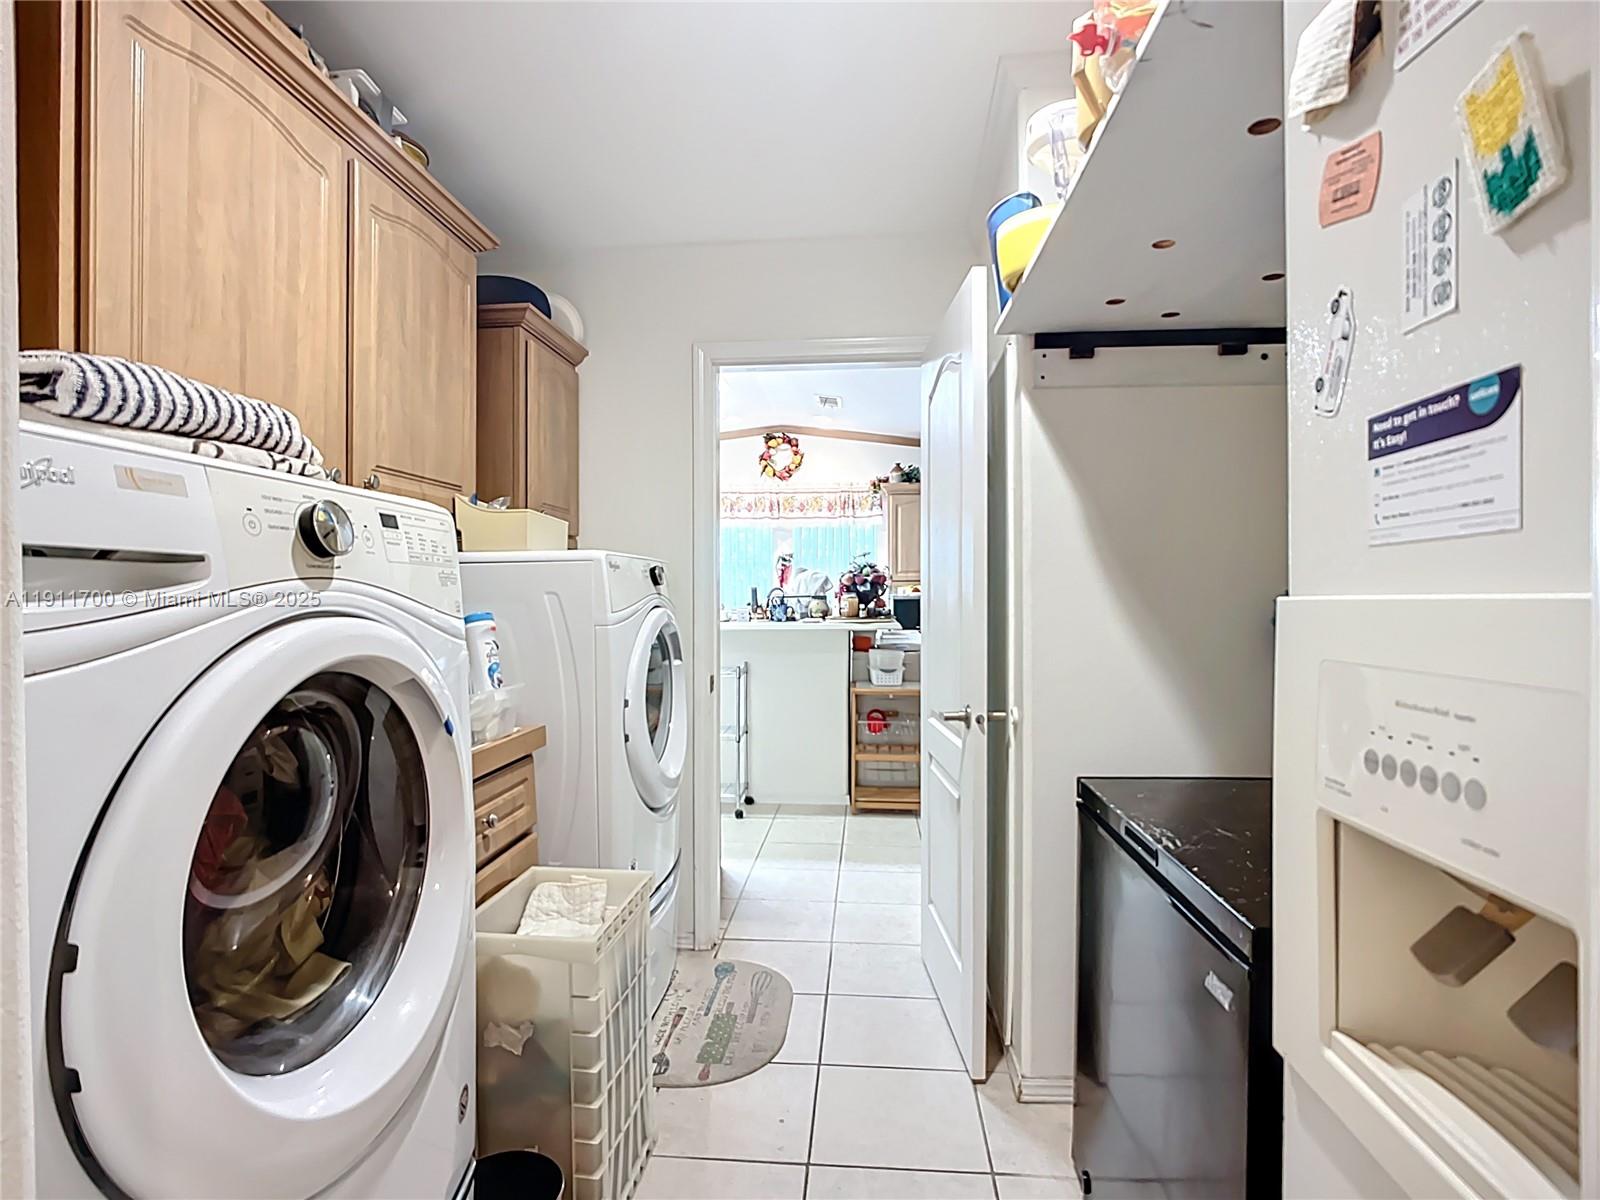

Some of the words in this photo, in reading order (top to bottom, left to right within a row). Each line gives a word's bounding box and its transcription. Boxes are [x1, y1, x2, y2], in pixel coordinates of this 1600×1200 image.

[1373, 415, 1393, 433] Need
[1393, 416, 1402, 426] to
[1403, 410, 1417, 427] get
[1418, 404, 1427, 418] in
[1428, 394, 1460, 416] touch?
